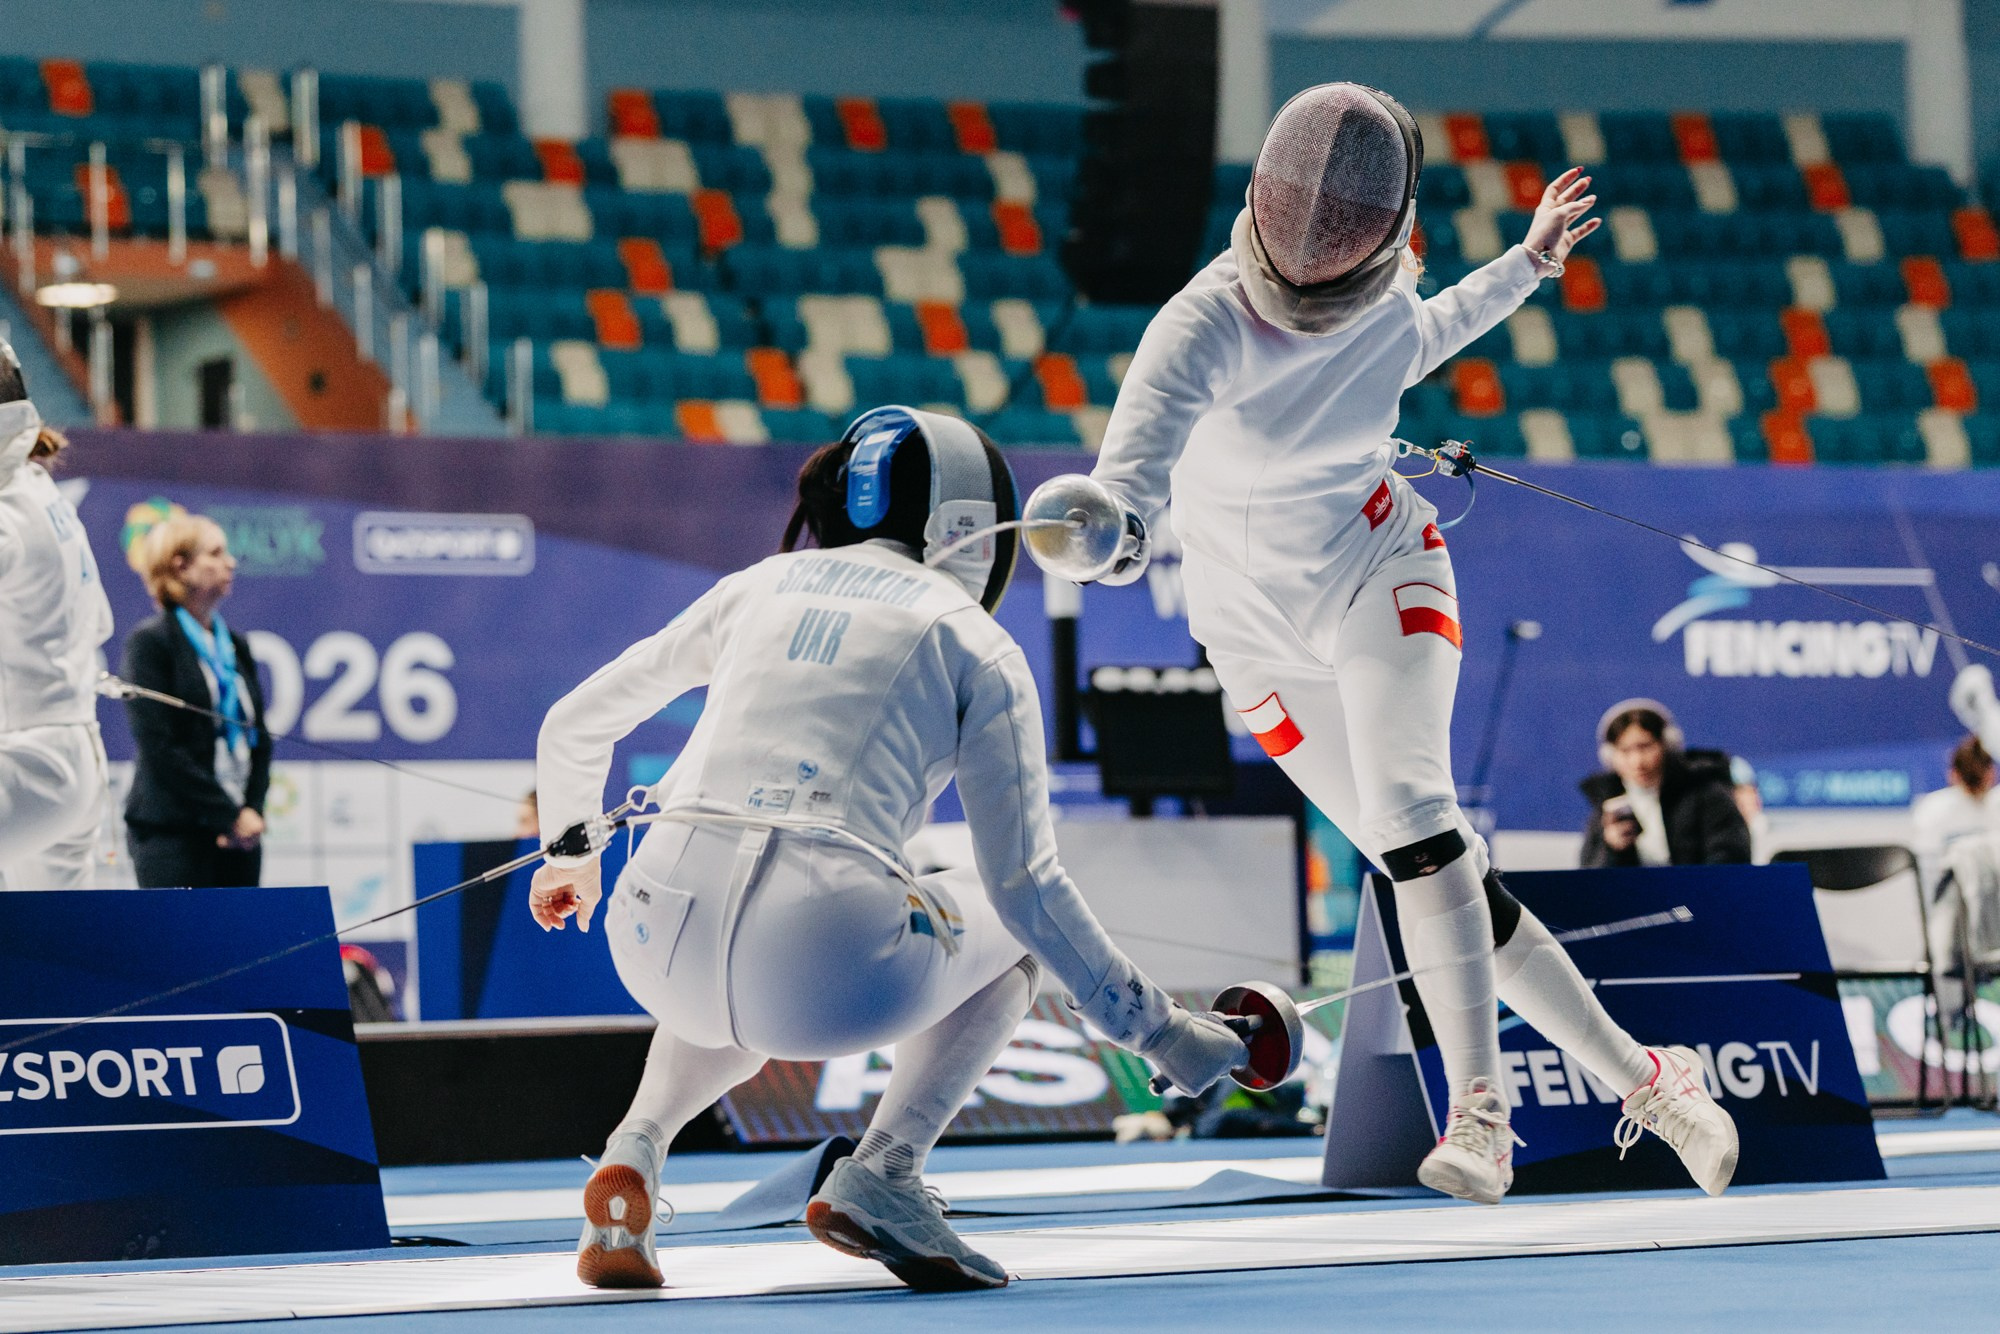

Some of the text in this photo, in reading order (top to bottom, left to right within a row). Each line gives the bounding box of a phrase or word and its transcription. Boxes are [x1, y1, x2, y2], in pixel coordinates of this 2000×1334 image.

[775, 557, 932, 608] SHEMYAKINA
[787, 607, 852, 666] UKR
[246, 629, 458, 744] 026
